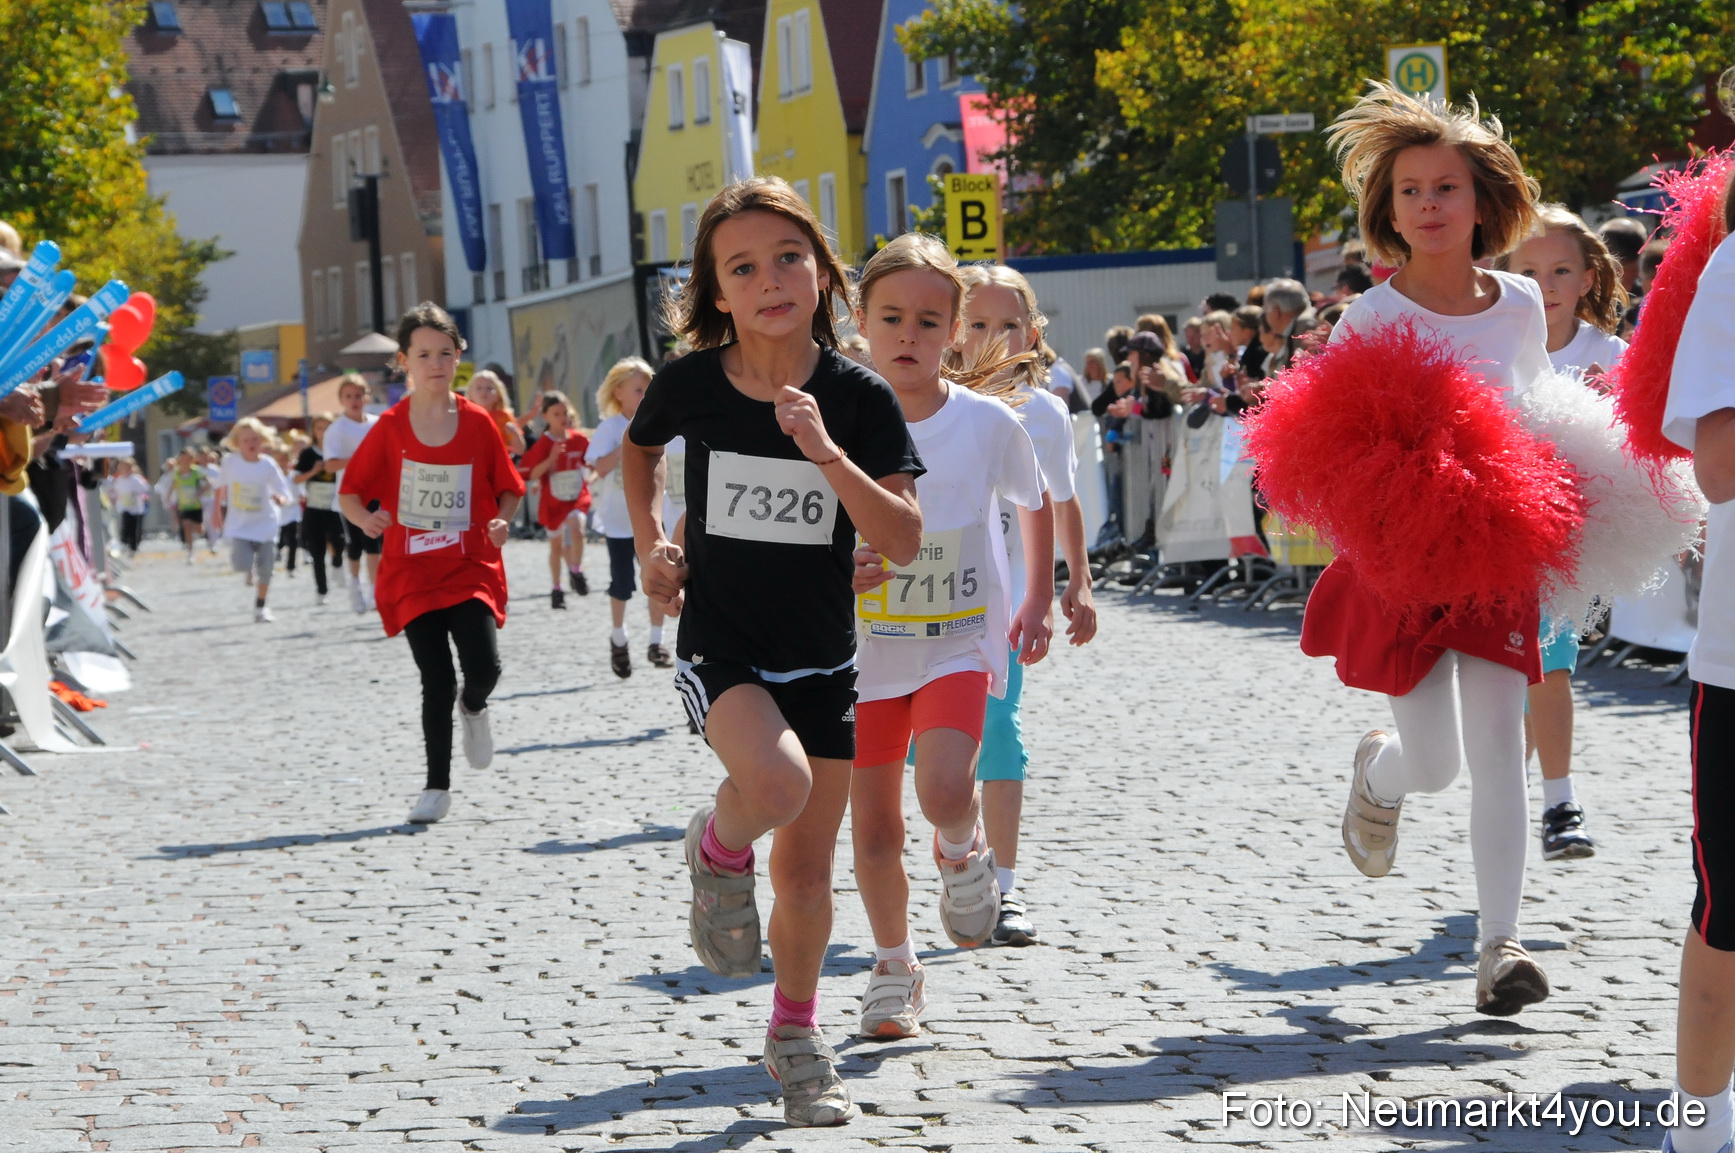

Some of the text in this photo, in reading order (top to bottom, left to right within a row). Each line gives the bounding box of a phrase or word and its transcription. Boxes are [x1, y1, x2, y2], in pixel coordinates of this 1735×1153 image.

[1407, 62, 1428, 87] H
[535, 91, 564, 185] RUPPERT
[952, 178, 993, 193] Block
[961, 201, 988, 240] B
[418, 468, 449, 483] Sarah
[418, 489, 466, 509] 7038
[725, 482, 824, 525] 7326
[896, 566, 978, 603] 7115
[871, 622, 906, 633] BOCK
[941, 613, 986, 630] PFLEIDERER
